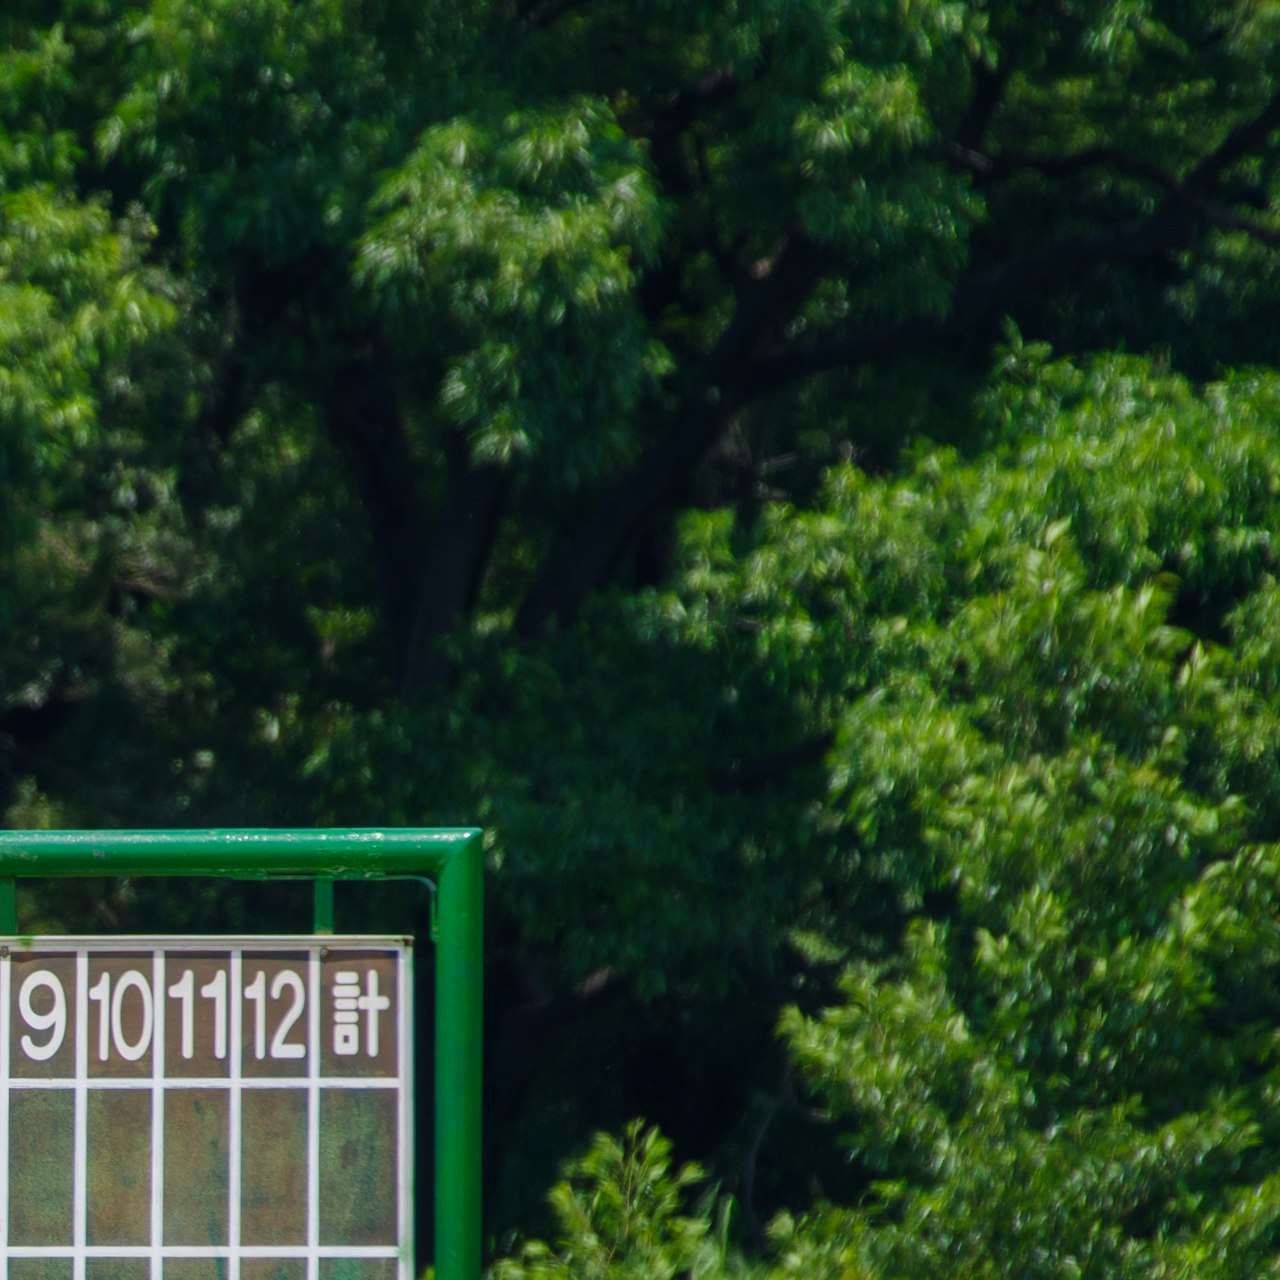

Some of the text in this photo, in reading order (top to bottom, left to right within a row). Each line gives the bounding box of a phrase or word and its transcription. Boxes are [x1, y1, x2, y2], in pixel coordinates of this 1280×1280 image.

[18, 969, 67, 1061] 9
[88, 969, 154, 1062] 10
[167, 969, 227, 1060] 11
[243, 969, 306, 1060] 12
[331, 969, 390, 1058] 計
